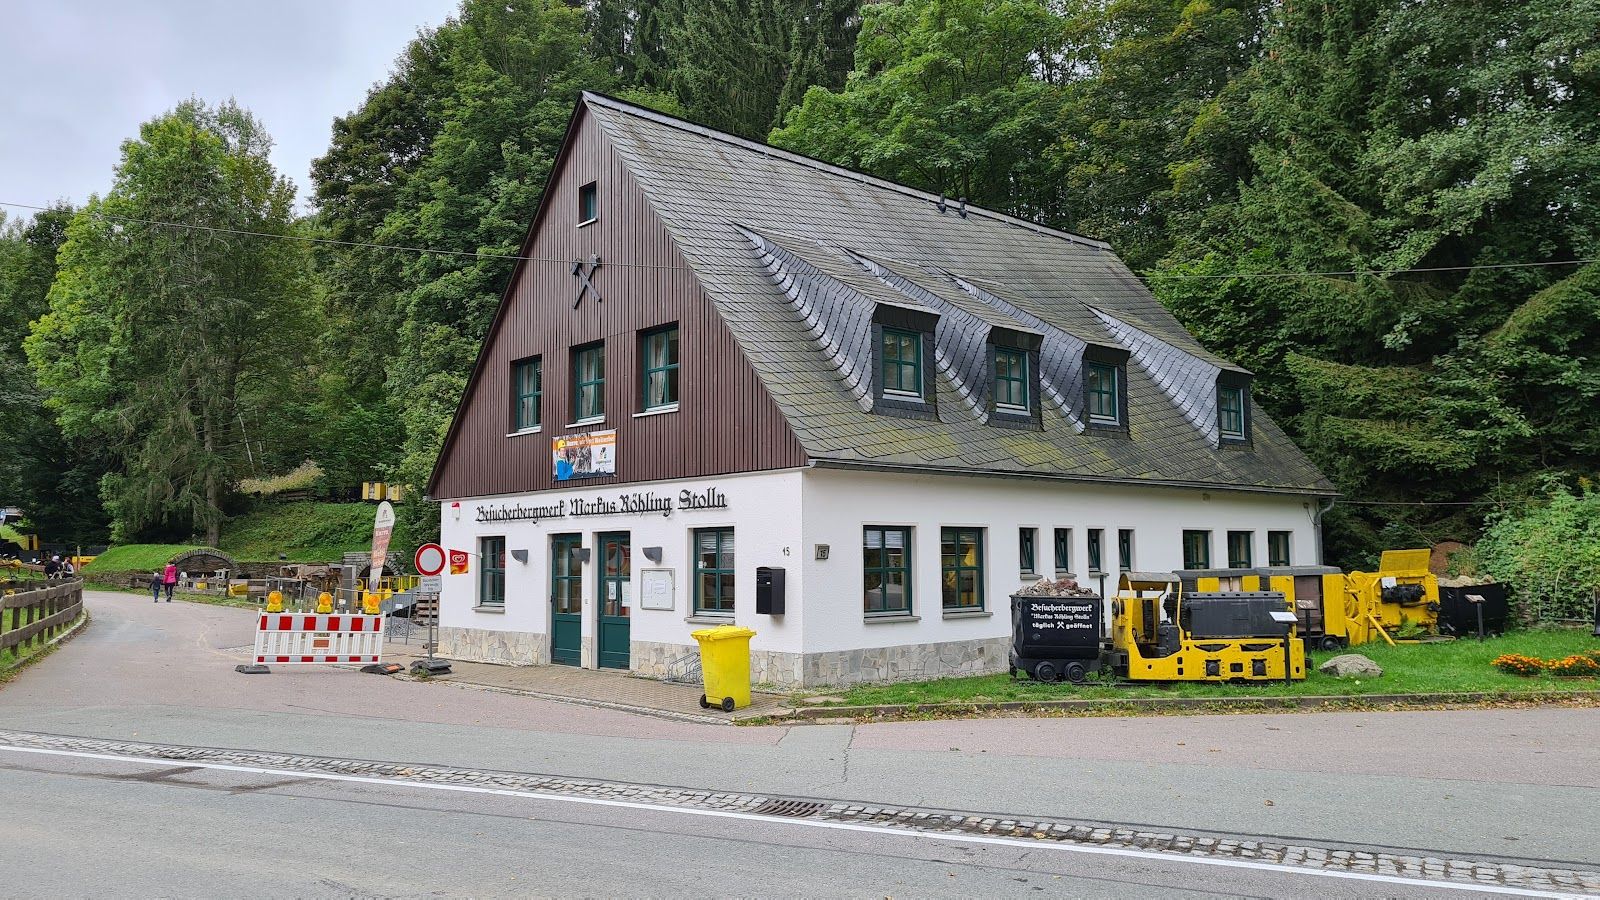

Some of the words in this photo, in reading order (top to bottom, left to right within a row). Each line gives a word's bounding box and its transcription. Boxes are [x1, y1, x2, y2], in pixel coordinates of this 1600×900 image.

[569, 496, 616, 516] Markus
[619, 491, 672, 517] Röhling
[678, 487, 728, 510] Stolln
[782, 546, 790, 557] 15
